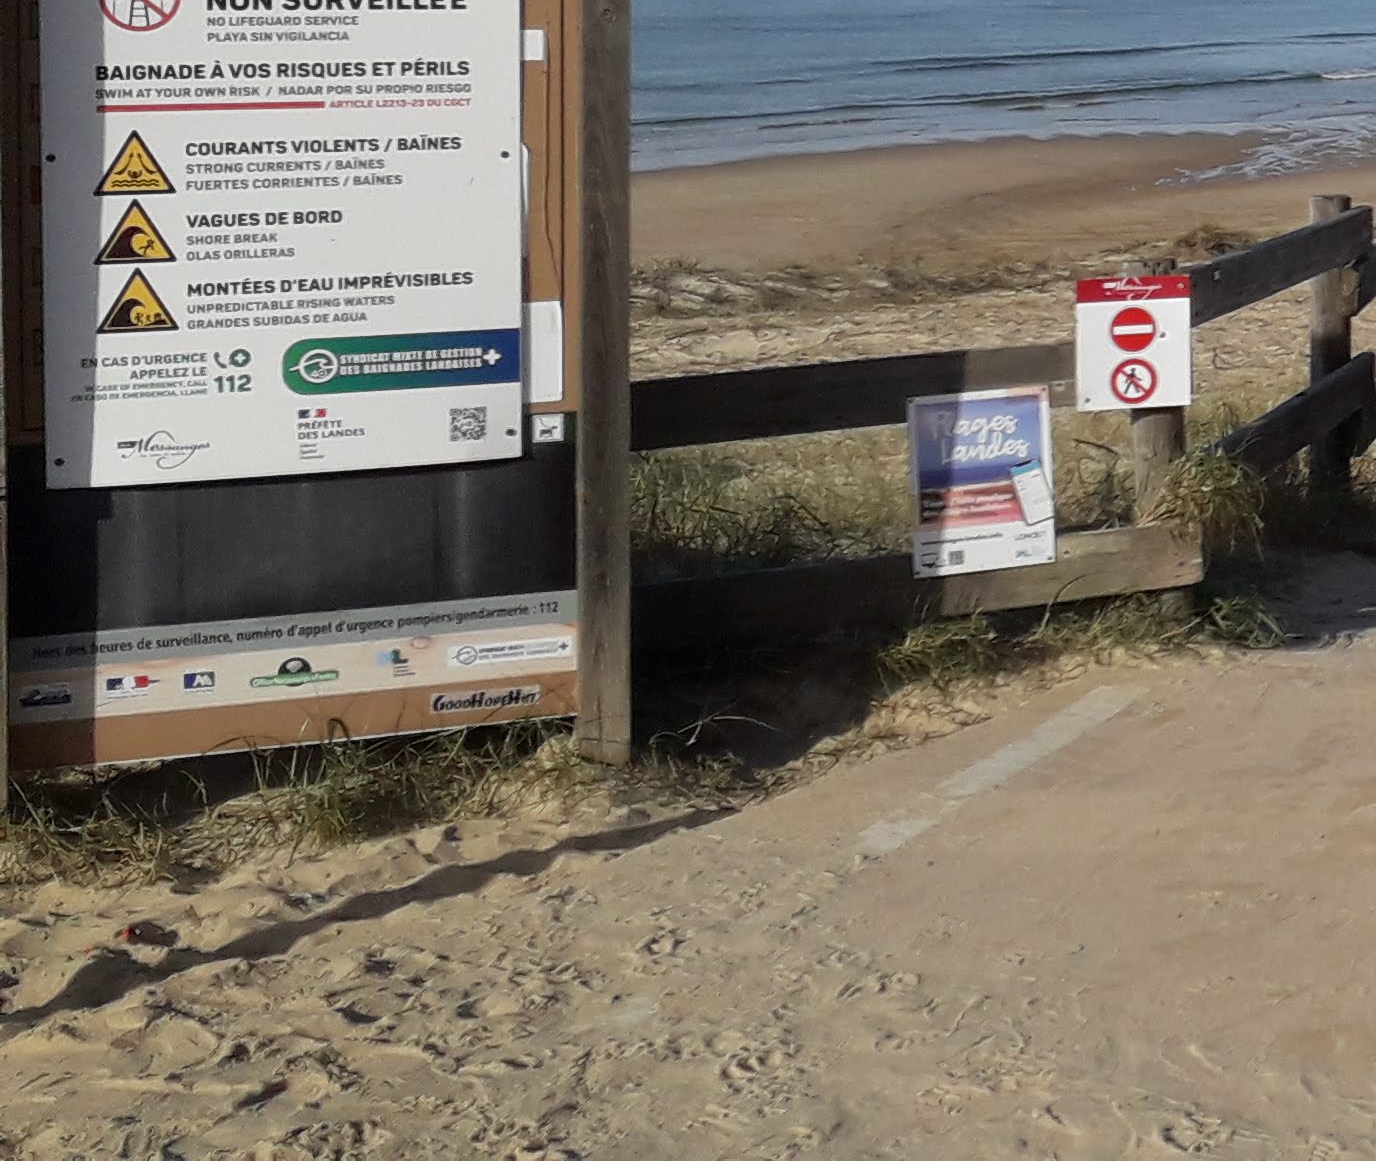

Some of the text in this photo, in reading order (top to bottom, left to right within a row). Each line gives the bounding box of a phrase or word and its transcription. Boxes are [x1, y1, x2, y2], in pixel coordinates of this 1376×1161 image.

[207, 16, 359, 27] NO LIFEGUARD SERVICE
[207, 31, 349, 43] PLAYA SIN VIGILANCIA
[96, 57, 470, 81] BAIGNADE À VOS RISQUES ET PÉRILS
[95, 87, 134, 99] SWIM
[136, 87, 153, 99] AT
[153, 86, 192, 99] YOUR
[194, 85, 226, 98] OWN
[230, 85, 260, 97] RISK
[278, 84, 323, 96] NADAR
[326, 84, 353, 95] POR
[355, 84, 373, 95] SU
[376, 83, 422, 94] PROPIO
[425, 82, 472, 94] RIESGO
[329, 99, 373, 109] ARTICLE
[427, 98, 442, 108] DU
[185, 134, 462, 157] COURANTS VIOLENTS / BAÏNES
[185, 162, 243, 175] STRONG
[246, 159, 321, 173] CURRENTS
[335, 157, 385, 171] BAÏNES
[185, 177, 248, 191] FUERTES
[252, 175, 339, 189] CORRIENTES
[353, 173, 403, 187] BAÏNES
[185, 210, 343, 228] VAGUES DE BORD
[186, 233, 278, 246] SHORE BREAK
[186, 247, 295, 262] OLAS ORILLERAS
[187, 278, 276, 298] MONTÉES
[338, 271, 474, 290] IMPRÉVISIBLES
[187, 295, 396, 314] UNPREDICTABLE RISING WATERS
[187, 312, 367, 330] GRANDES SUBIDAS DE AGUA
[101, 357, 128, 368] CAS
[339, 352, 391, 365] SYNDICAT
[129, 366, 207, 380] APPELEZ LE
[340, 364, 360, 376] DES
[213, 374, 252, 393] 112
[298, 428, 365, 440] DES LANDES
[136, 637, 152, 650] de
[236, 626, 282, 641] numéro
[539, 601, 559, 614] 112
